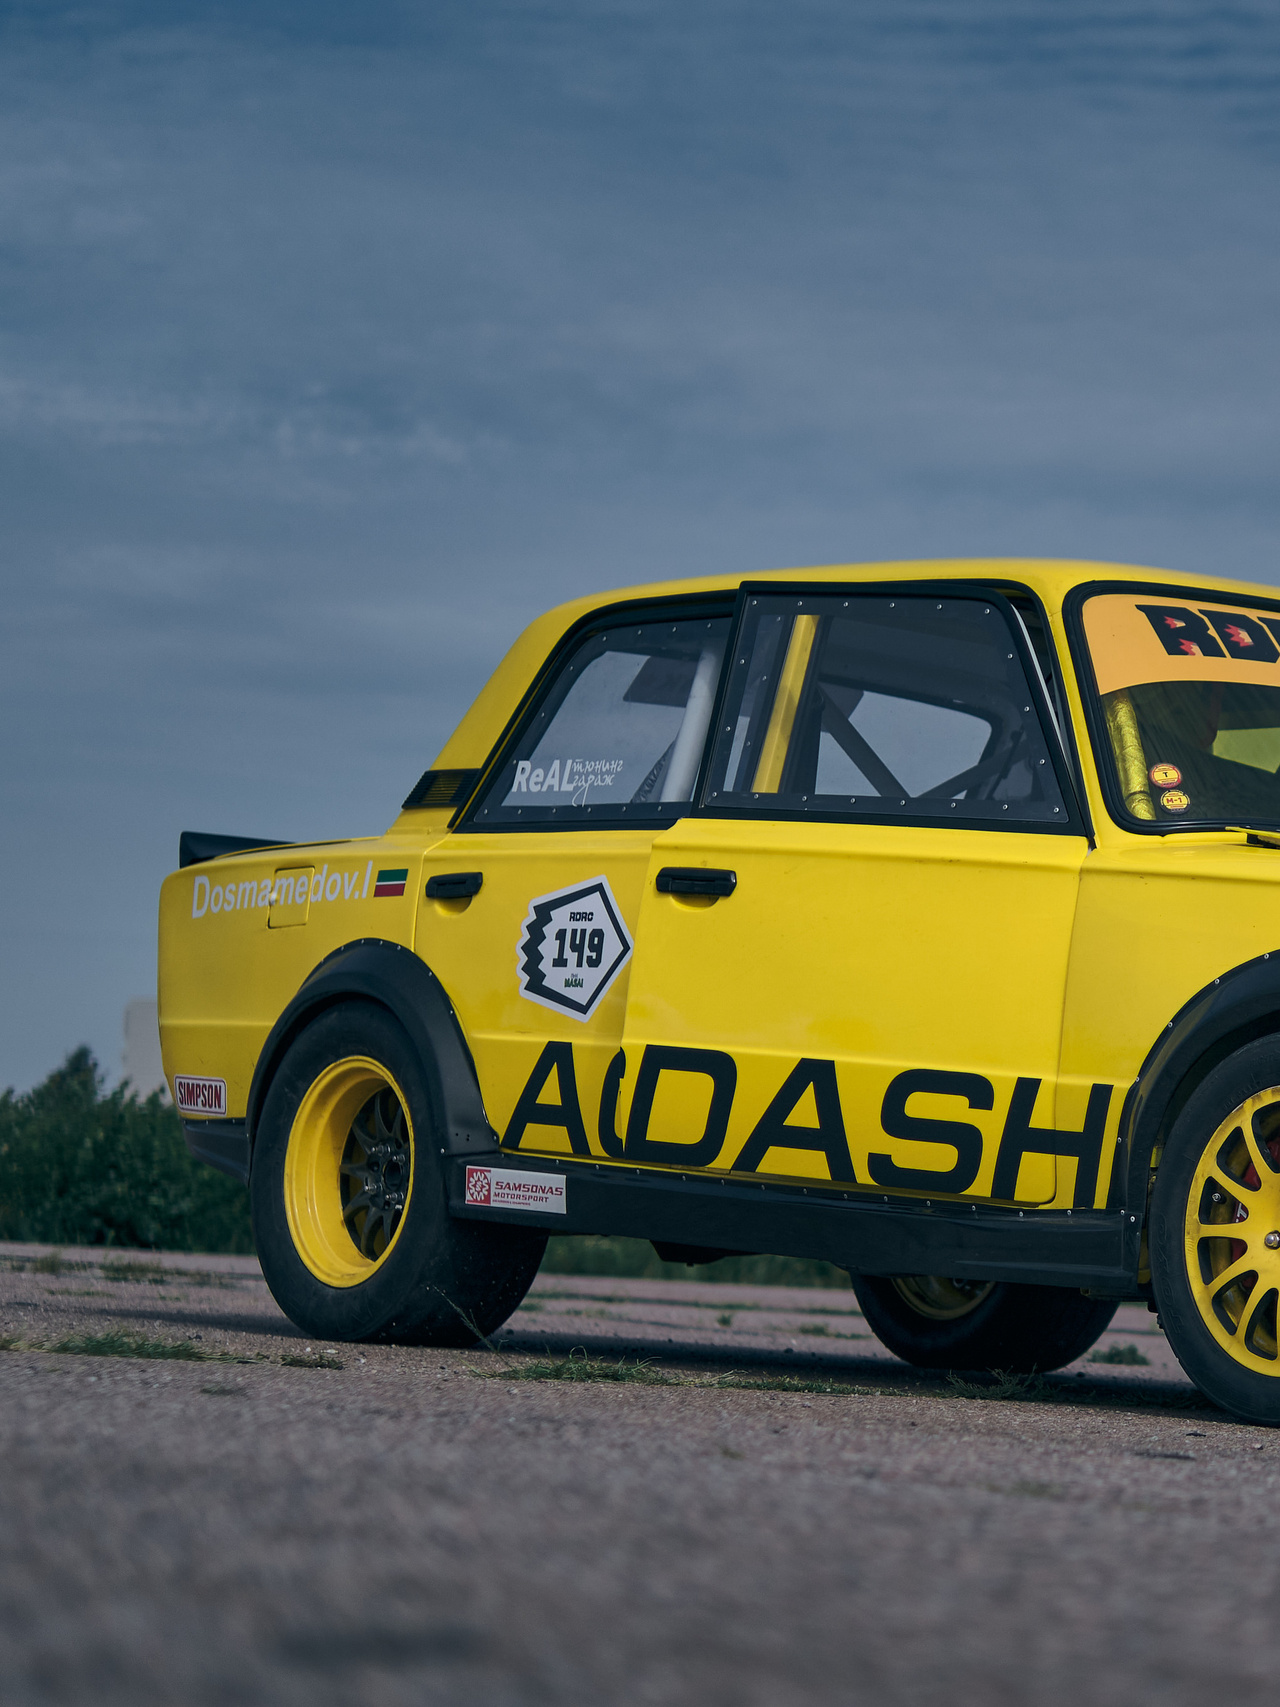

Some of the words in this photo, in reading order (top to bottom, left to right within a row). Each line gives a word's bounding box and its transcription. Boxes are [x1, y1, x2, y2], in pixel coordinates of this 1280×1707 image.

[511, 759, 576, 792] ReAL
[572, 759, 623, 774] тюнинг
[572, 774, 615, 807] гараж
[569, 911, 594, 922] RDRC
[552, 928, 605, 968] 149
[178, 1081, 222, 1109] SIMPSON
[493, 1192, 549, 1203] MOTORSPORT
[495, 1181, 564, 1196] SAMSONAS
